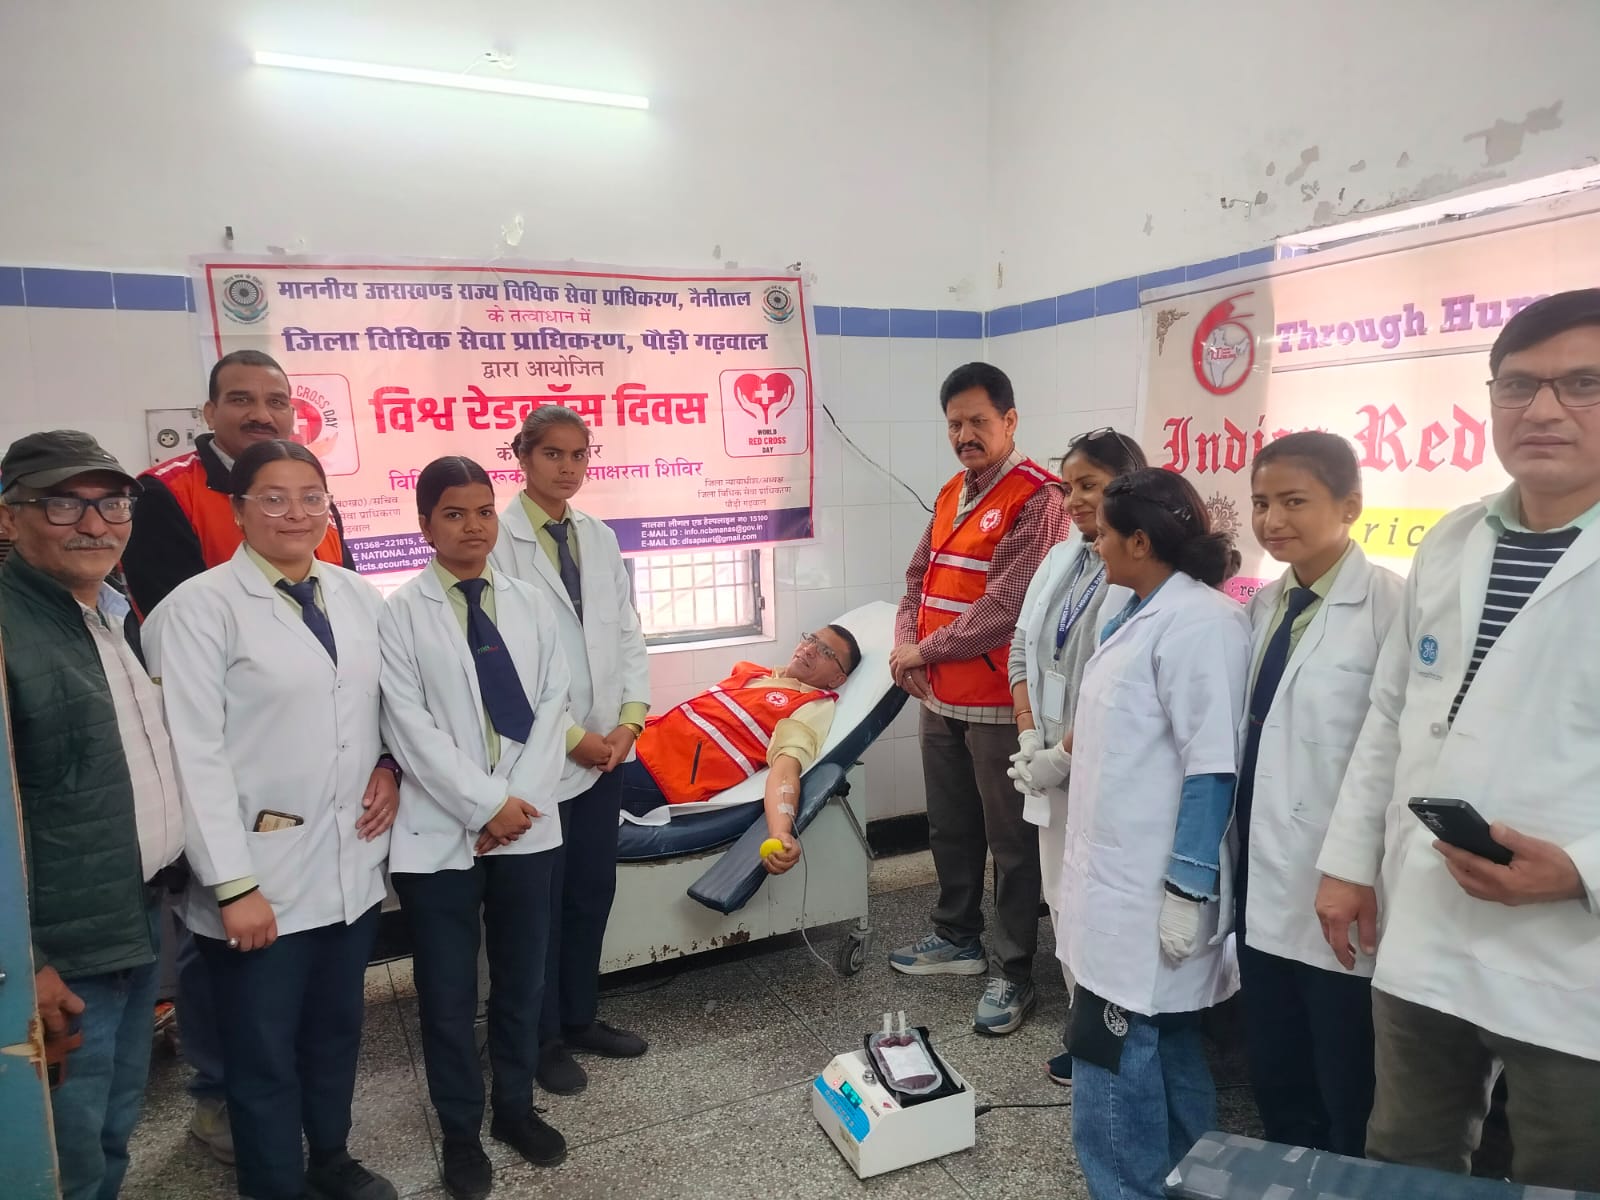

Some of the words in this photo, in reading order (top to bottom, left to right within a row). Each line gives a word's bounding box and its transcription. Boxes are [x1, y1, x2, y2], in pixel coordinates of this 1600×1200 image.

[277, 277, 358, 300] माननीय
[363, 281, 453, 301] उत्तराखण्ड
[457, 284, 499, 301] राज्य
[503, 280, 559, 302] विधिक
[565, 283, 597, 304] सेवा
[602, 286, 683, 311] प्राधिकरण,
[690, 288, 751, 308] नैनीताल
[486, 305, 505, 323] के
[578, 307, 592, 324] में
[1276, 302, 1428, 350] Through
[1440, 294, 1552, 333] Hum
[281, 326, 360, 352] जिला
[365, 326, 452, 351] विधिक
[457, 326, 506, 351] सेवा
[511, 327, 634, 354] प्राधिकरण,
[641, 329, 689, 355] पौड़ी
[693, 333, 769, 355] गढ़वाल
[481, 361, 519, 378] द्वारा
[525, 355, 604, 377] आयोजित
[297, 385, 330, 409] CROSS
[322, 409, 338, 429] DAY
[369, 386, 458, 434] विश्व
[612, 382, 708, 427] दिवस
[748, 437, 762, 445] RED
[764, 436, 787, 445] CROSS
[1162, 415, 1329, 474] Indi
[1354, 403, 1486, 472] Red
[762, 446, 774, 454] DAY
[655, 458, 703, 477] शिविर
[641, 529, 669, 538] E-MAIL
[641, 538, 669, 548] E-MAIL
[361, 548, 407, 560] NATIONAL
[409, 545, 437, 555] ANTIN
